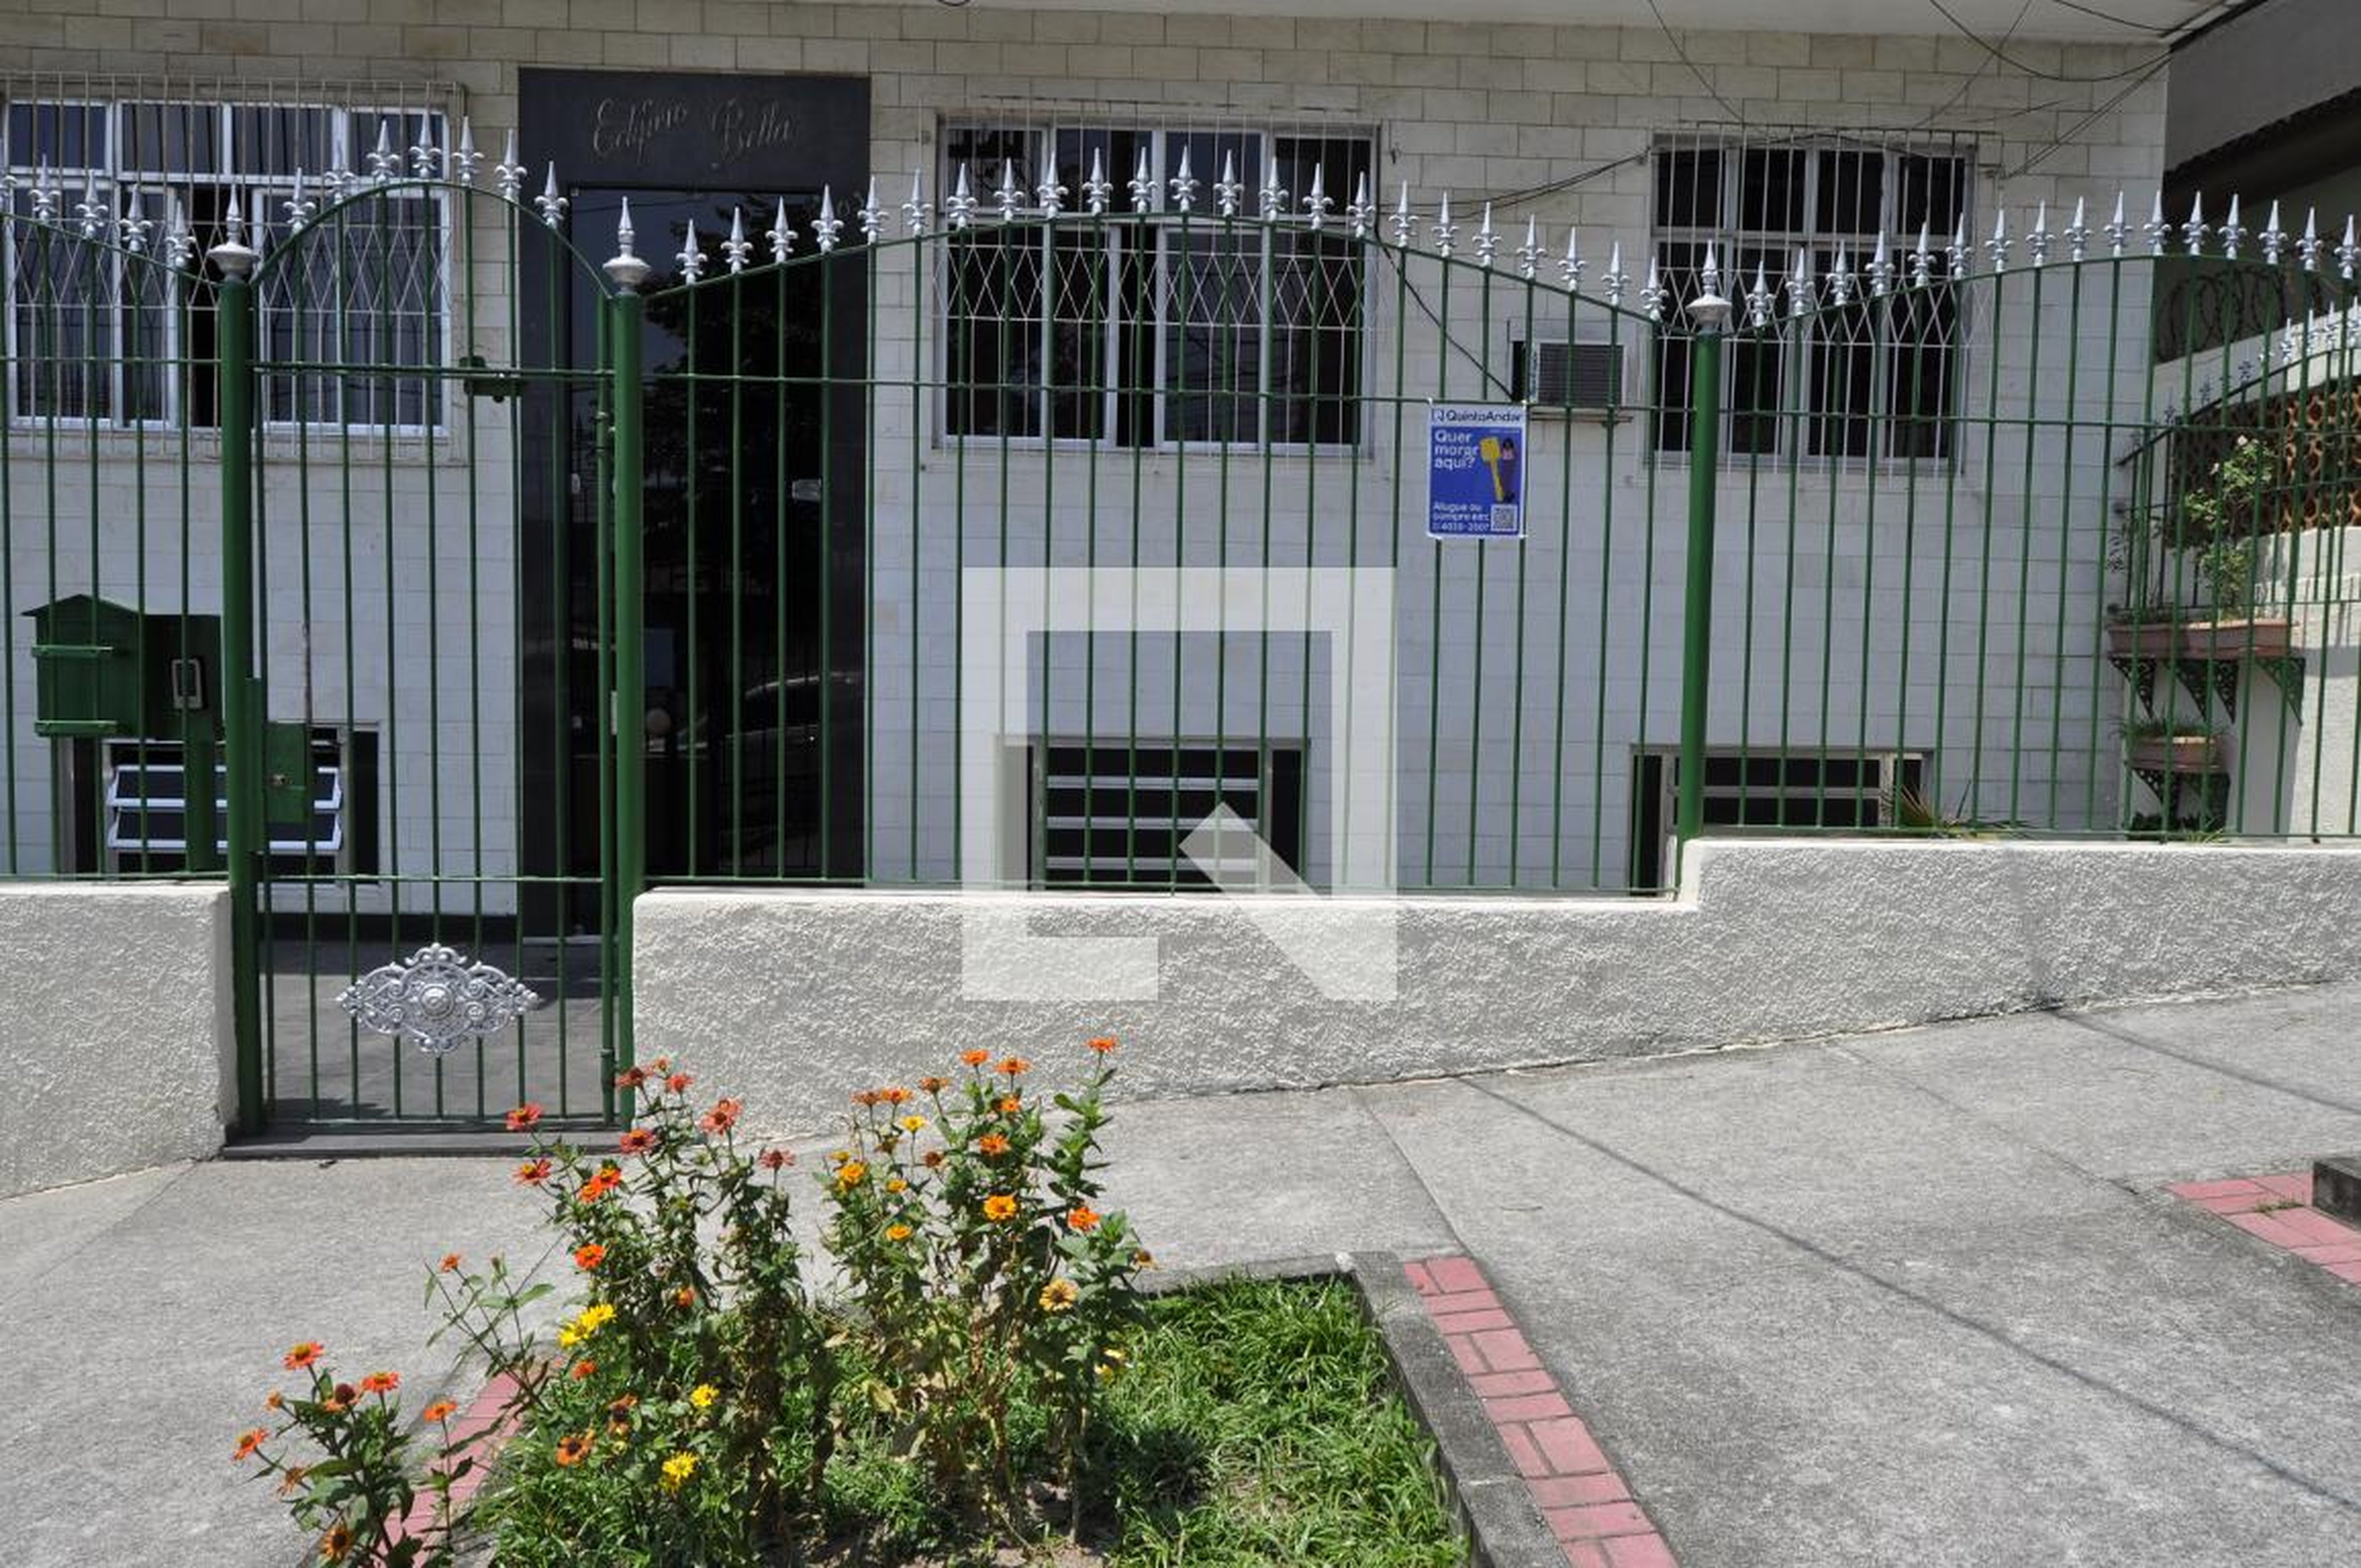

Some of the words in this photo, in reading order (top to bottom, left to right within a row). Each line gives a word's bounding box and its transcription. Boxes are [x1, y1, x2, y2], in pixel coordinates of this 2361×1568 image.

[1445, 409, 1521, 422] QuintoAndar
[1435, 430, 1472, 443] Quer
[1435, 446, 1479, 455] morar
[1434, 457, 1475, 471] aqui?
[1433, 502, 1467, 513] Alugue
